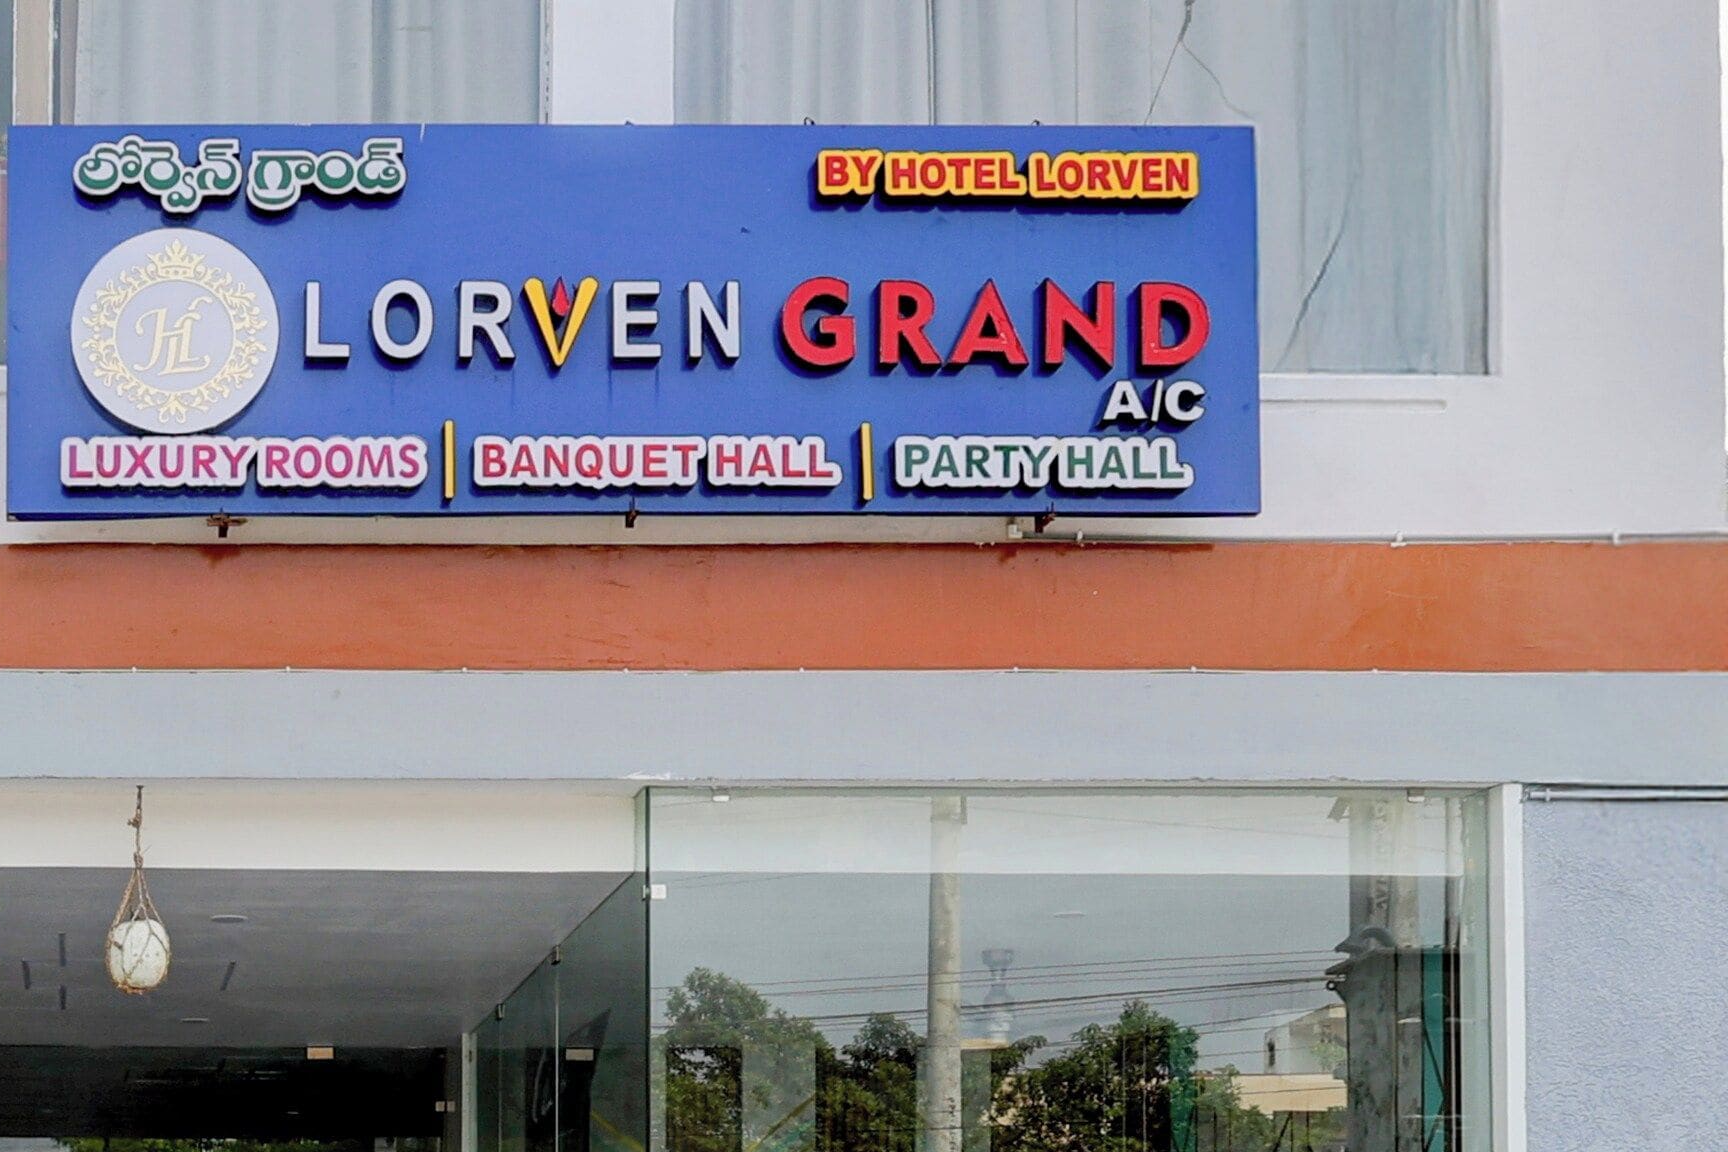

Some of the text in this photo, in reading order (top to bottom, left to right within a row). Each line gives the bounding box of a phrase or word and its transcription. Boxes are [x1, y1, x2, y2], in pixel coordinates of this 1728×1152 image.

[825, 156, 1190, 192] BY HOTEL LORVEN
[305, 276, 1210, 366] LORVEN GRAND
[1102, 379, 1206, 421] A/C
[68, 445, 421, 478] LUXURY ROOMS
[482, 445, 834, 481] BANQUET HALL
[904, 445, 1184, 480] PARTY HALL
